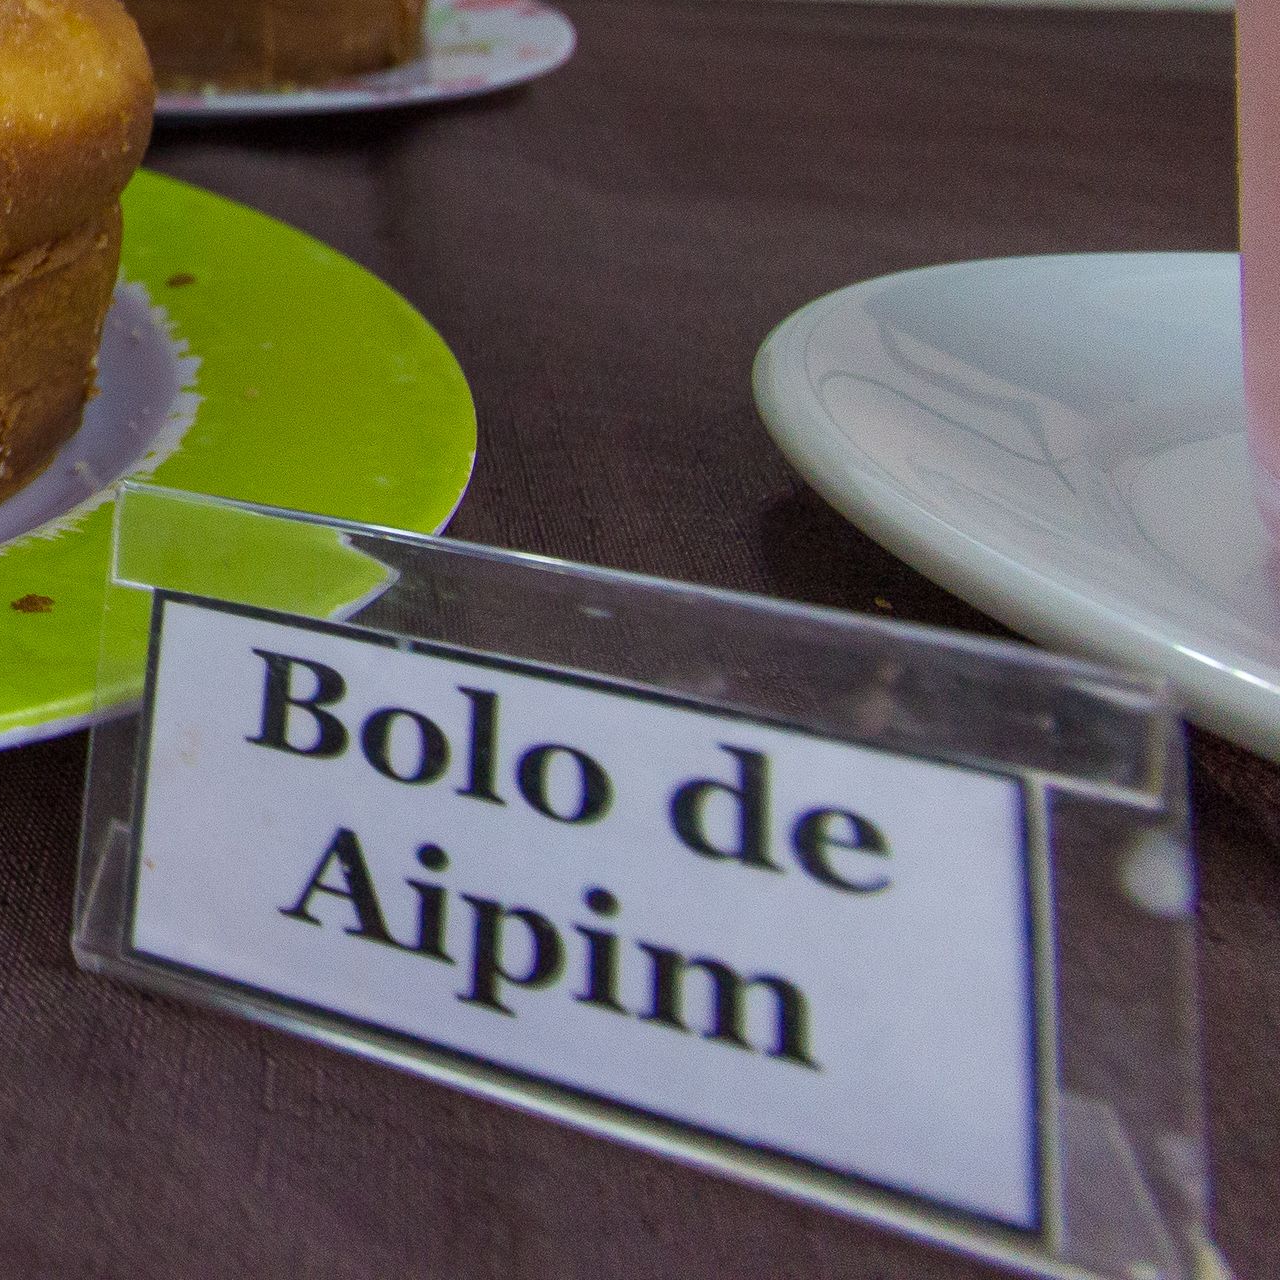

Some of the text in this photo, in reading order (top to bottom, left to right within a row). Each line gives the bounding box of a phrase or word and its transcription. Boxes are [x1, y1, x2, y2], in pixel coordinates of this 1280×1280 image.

[245, 647, 893, 895] Bolo de
[278, 825, 823, 1072] Aipim
